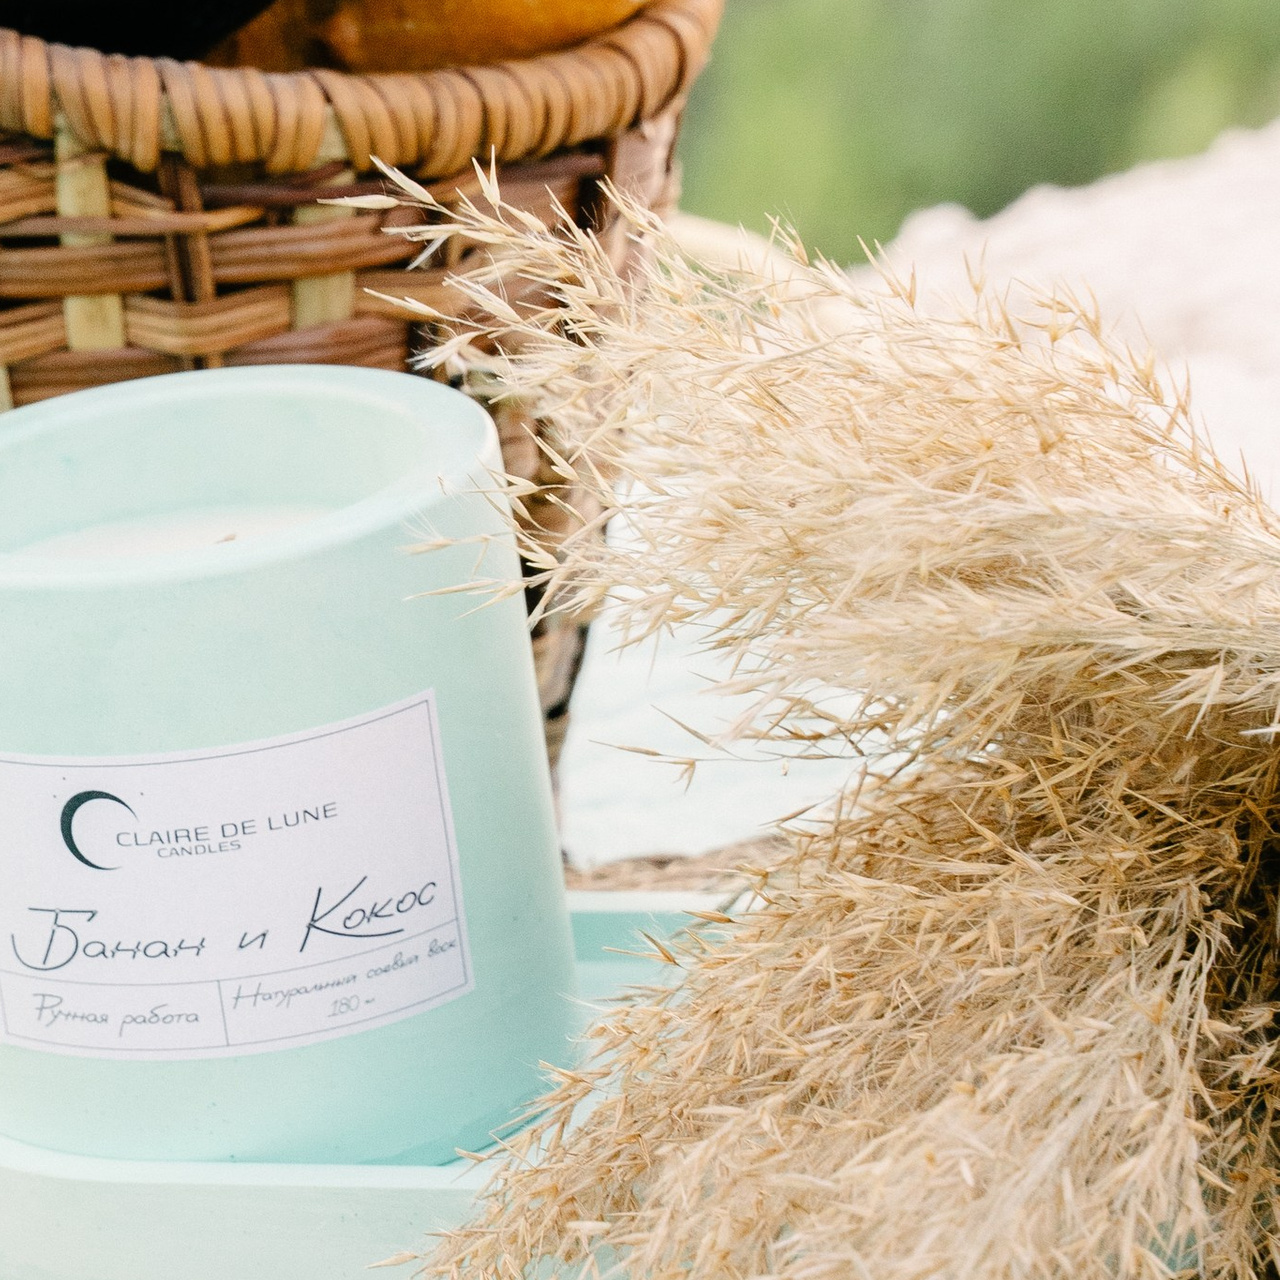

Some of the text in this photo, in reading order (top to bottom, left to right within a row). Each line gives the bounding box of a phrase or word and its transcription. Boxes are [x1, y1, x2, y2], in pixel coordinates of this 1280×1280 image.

[116, 801, 339, 848] CLAIRE DE LUNE
[157, 839, 242, 858] CANDLES
[11, 875, 437, 971] Банан и Кокос
[32, 992, 200, 1037] Ручная работа
[327, 994, 360, 1018] 180
